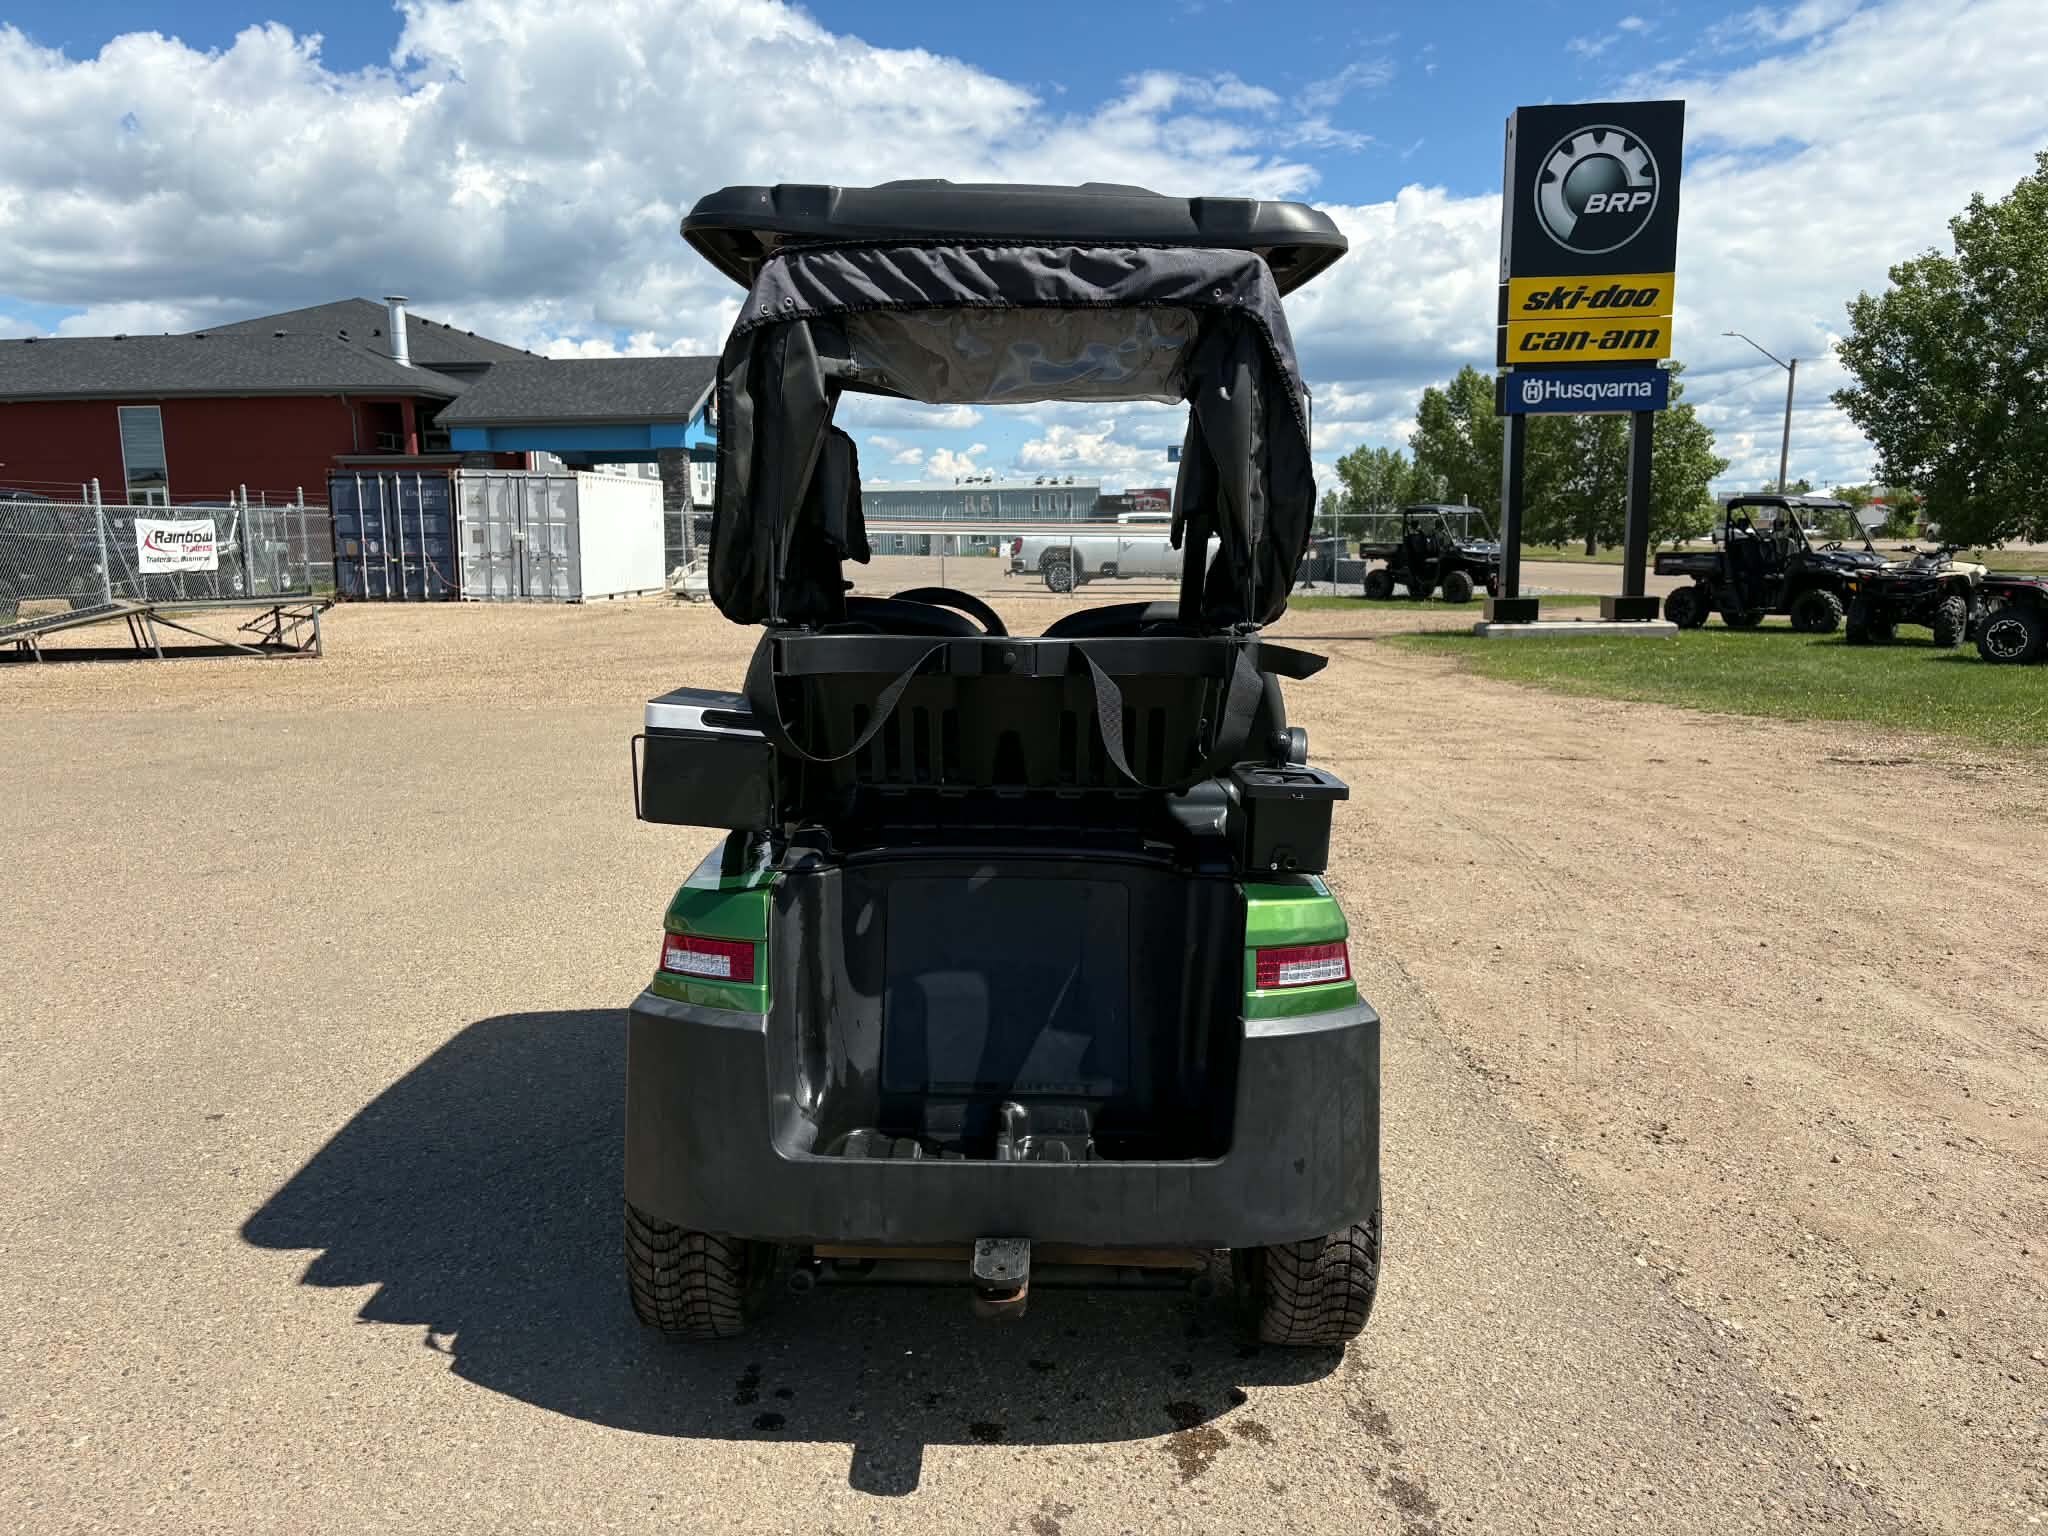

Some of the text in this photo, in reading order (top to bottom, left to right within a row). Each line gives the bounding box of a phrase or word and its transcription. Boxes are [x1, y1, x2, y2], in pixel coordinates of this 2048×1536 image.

[1584, 192, 1651, 214] BRP
[1522, 284, 1660, 311] ski-doo
[1519, 329, 1660, 352] can-am
[1545, 380, 1652, 401] Husqvarna
[154, 531, 213, 544] Rainbow
